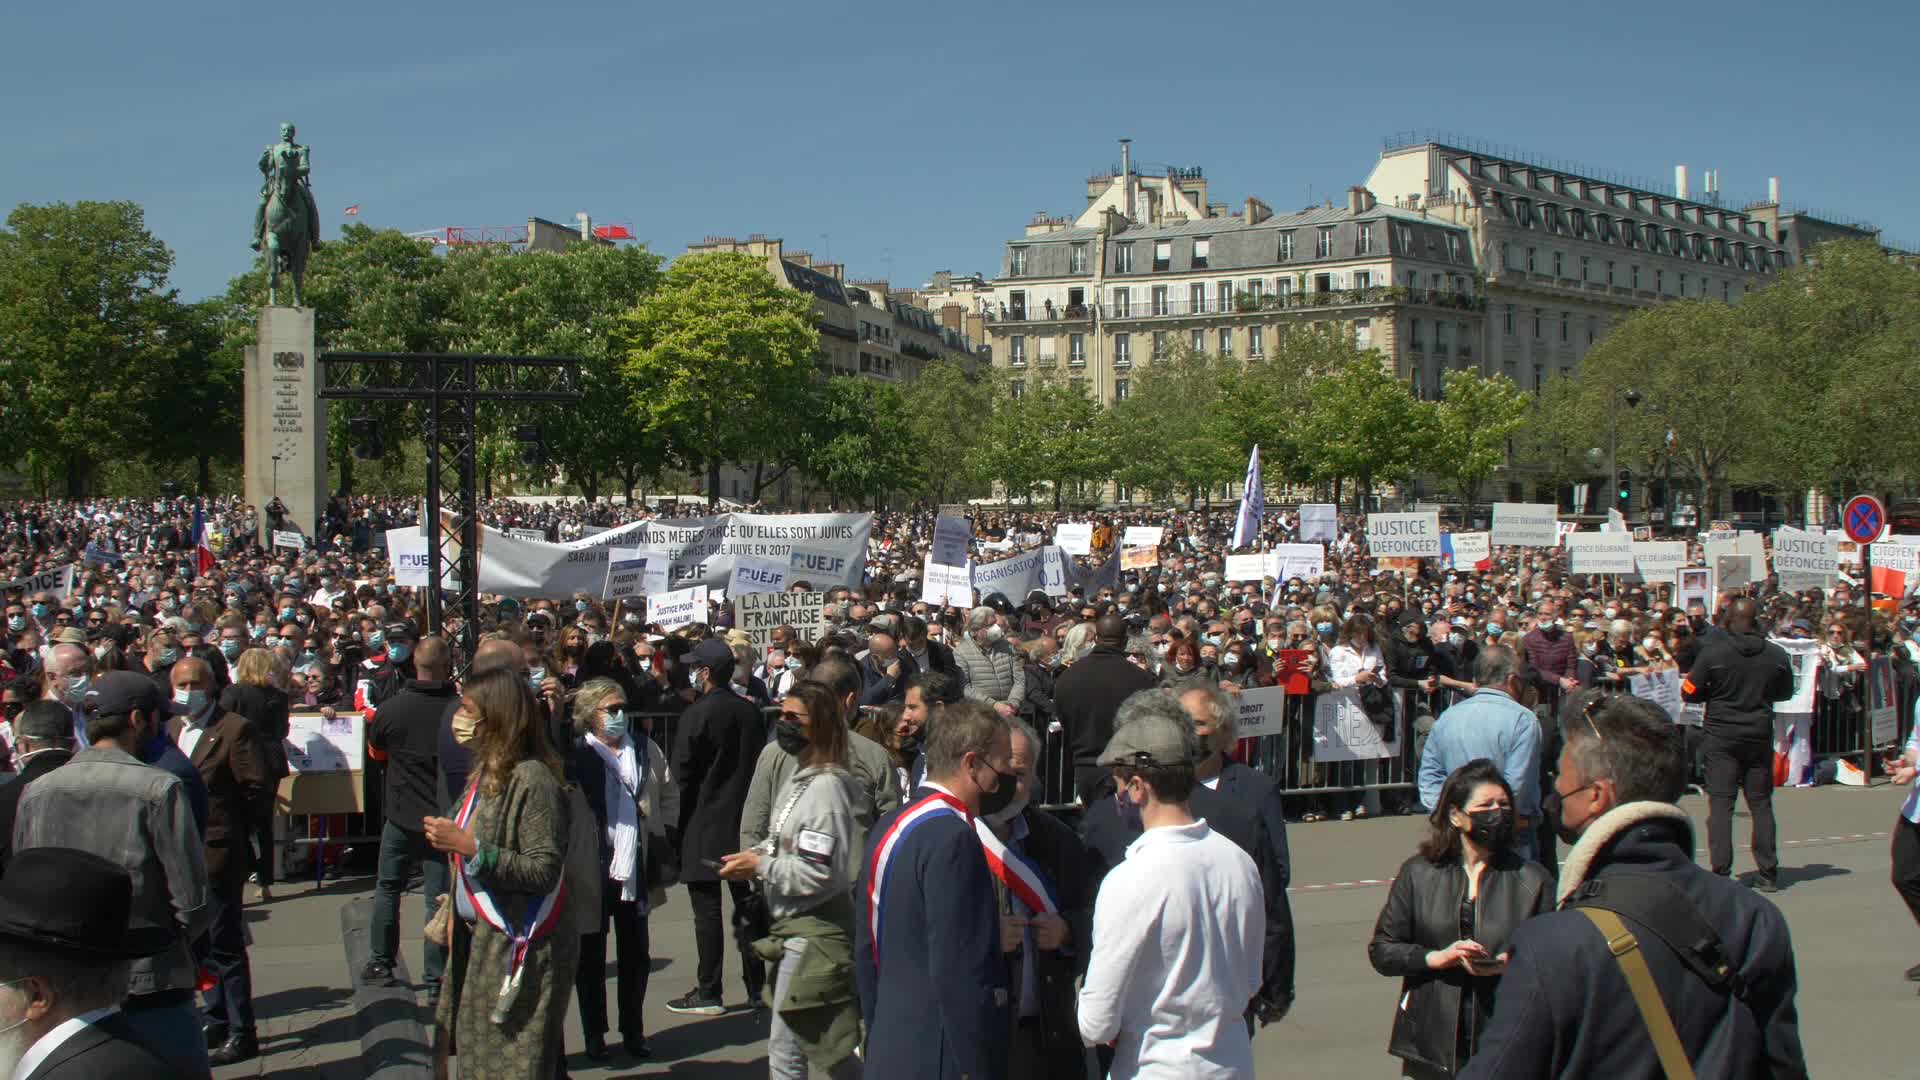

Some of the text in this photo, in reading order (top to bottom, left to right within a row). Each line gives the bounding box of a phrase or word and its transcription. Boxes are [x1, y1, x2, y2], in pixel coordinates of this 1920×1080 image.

[1372, 520, 1426, 535] JUSTICE
[625, 530, 665, 544] GRANDS
[790, 527, 817, 539] SONT
[819, 527, 853, 538] JUIVES
[729, 544, 753, 555] JUIVE
[755, 545, 767, 555] EN
[769, 545, 791, 556] 2017
[1373, 538, 1438, 553] DÉFONCÉE?
[1776, 540, 1826, 555] JUSTICE
[412, 554, 428, 566] UE
[806, 555, 844, 572] UEJF
[751, 569, 782, 585] UEJF
[657, 601, 693, 615] JUSTICE POUR
[742, 595, 759, 609] LA
[1240, 704, 1263, 714] DROIT
